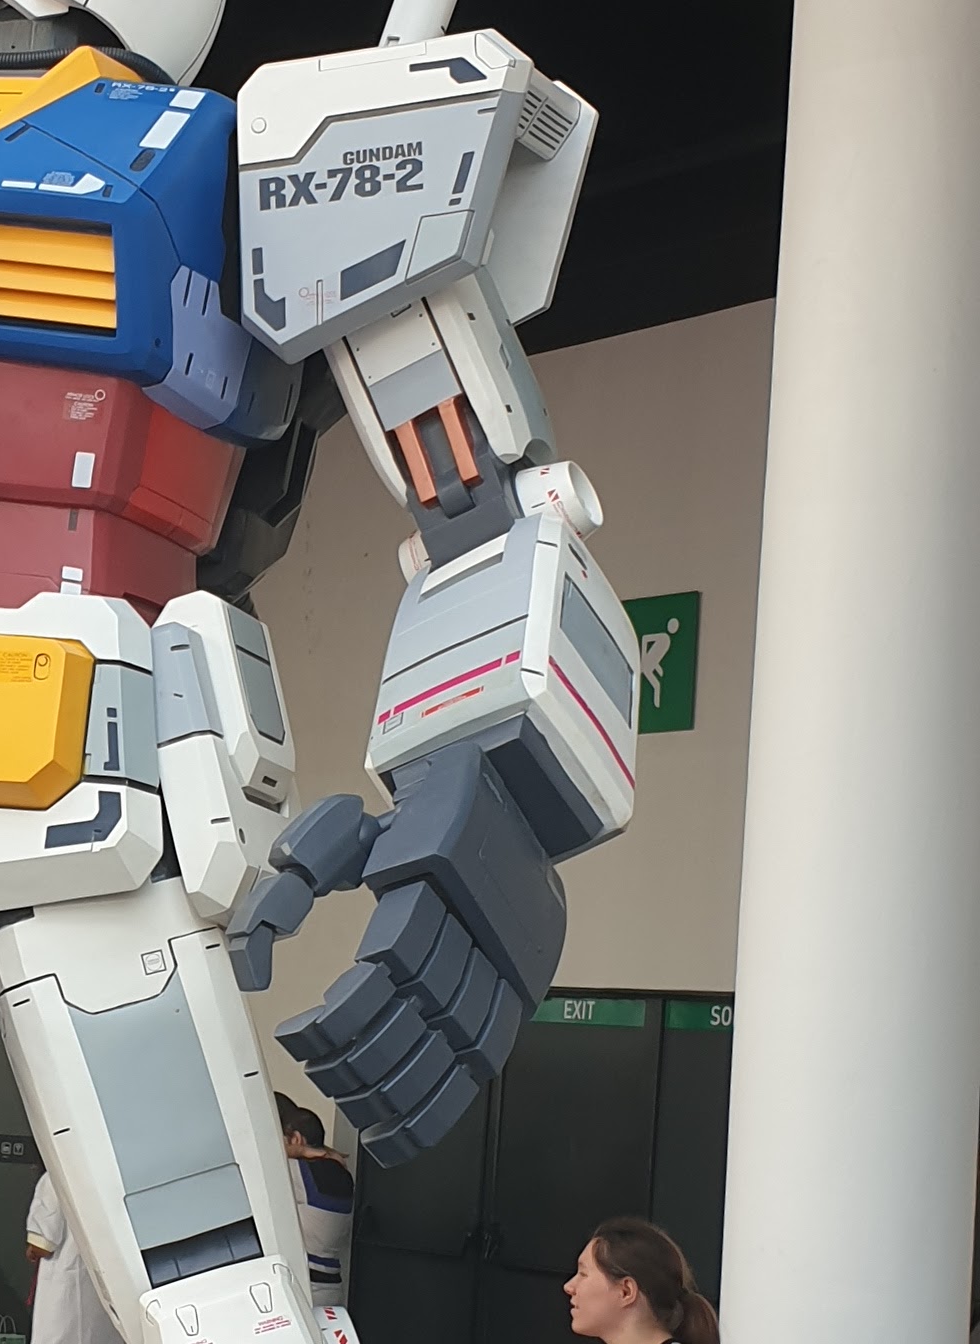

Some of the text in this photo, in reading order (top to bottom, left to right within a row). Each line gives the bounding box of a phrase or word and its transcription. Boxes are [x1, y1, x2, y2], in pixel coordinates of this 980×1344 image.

[343, 141, 423, 165] GUNDAM
[259, 158, 424, 211] RX-78-2
[563, 1000, 595, 1020] EXIT
